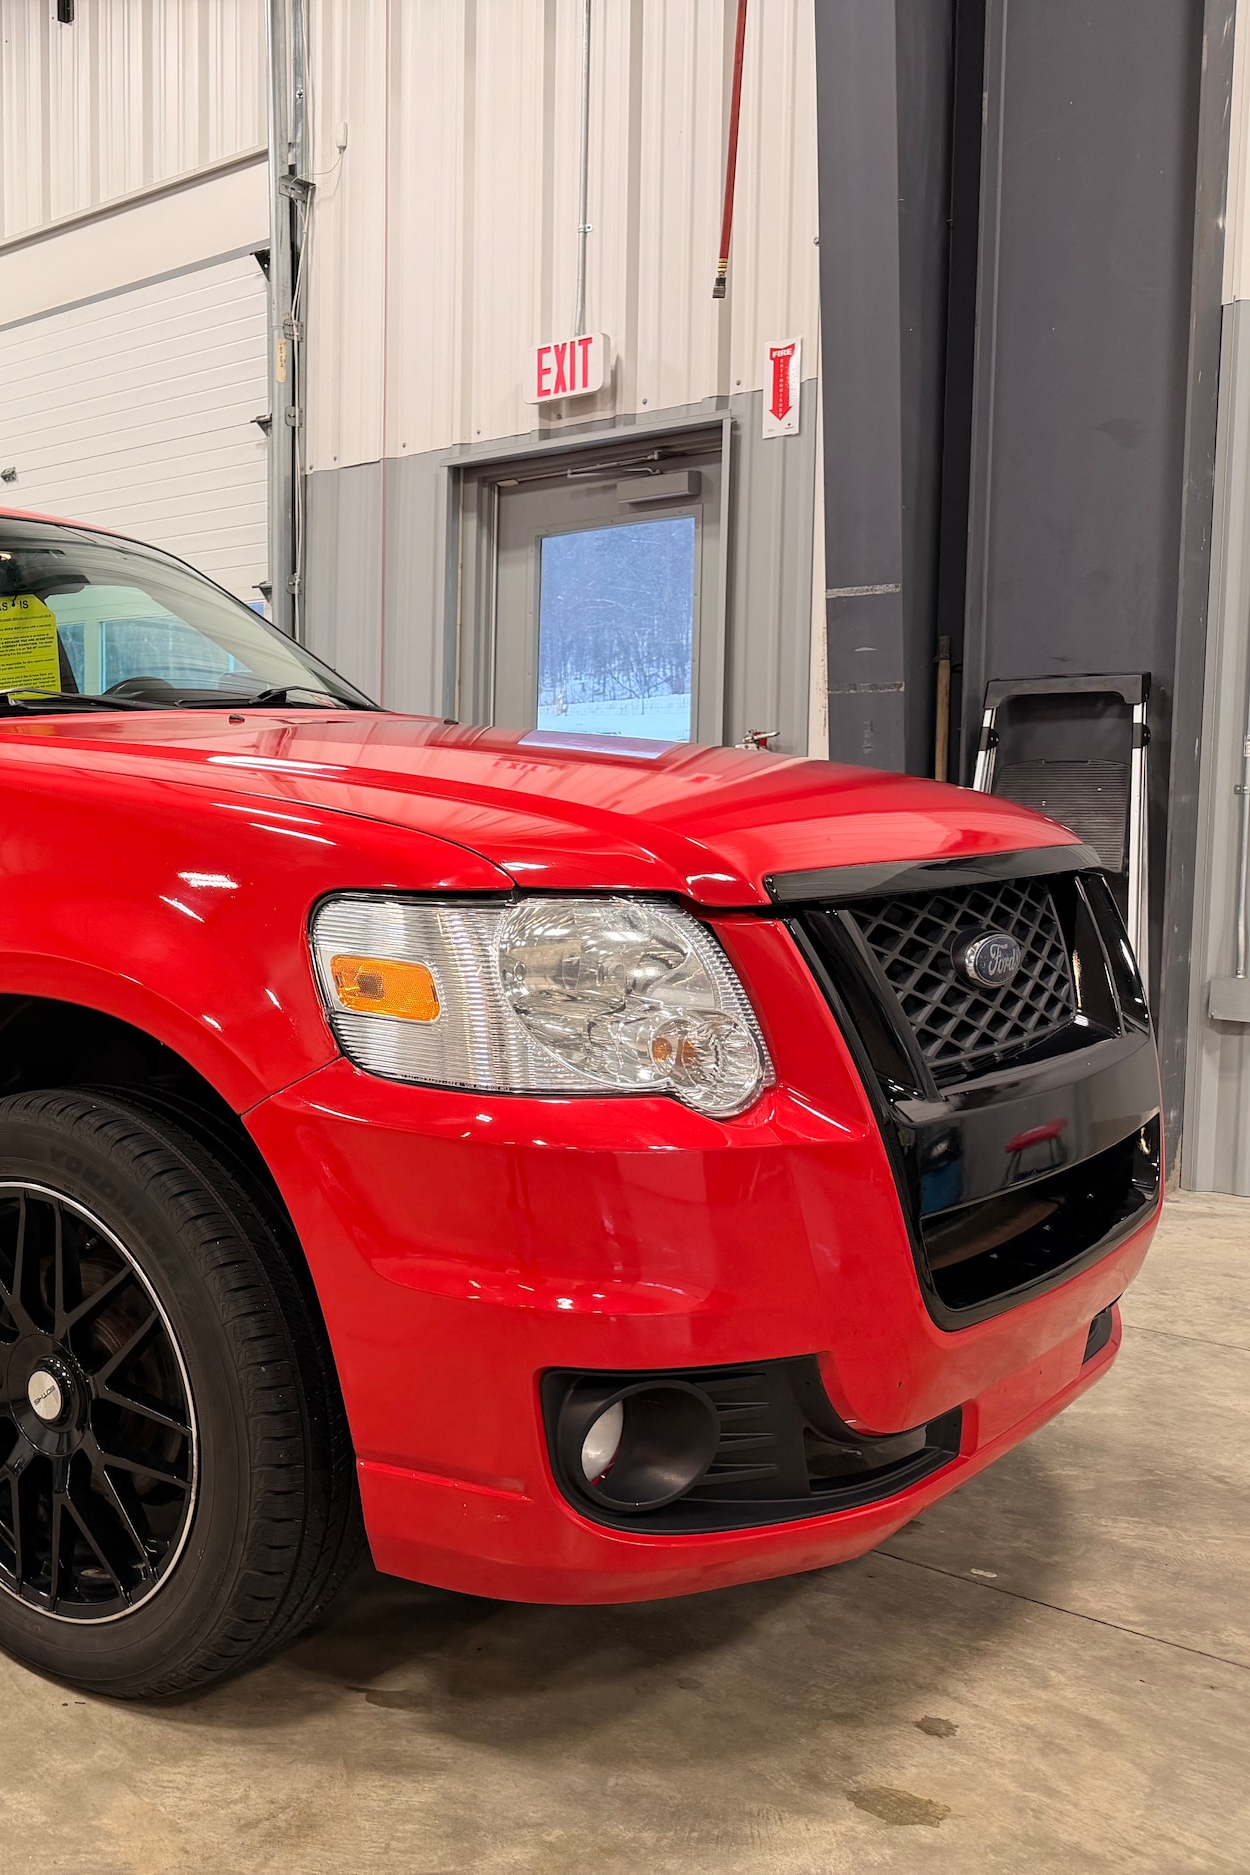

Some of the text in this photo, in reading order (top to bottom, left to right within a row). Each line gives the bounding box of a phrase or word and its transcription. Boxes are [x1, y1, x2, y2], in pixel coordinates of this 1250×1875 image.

[536, 336, 593, 398] EXIT
[771, 348, 793, 359] FIRE
[19, 600, 29, 609] IS
[988, 943, 1016, 976] Ford
[49, 1146, 182, 1284] YOKOHAMA
